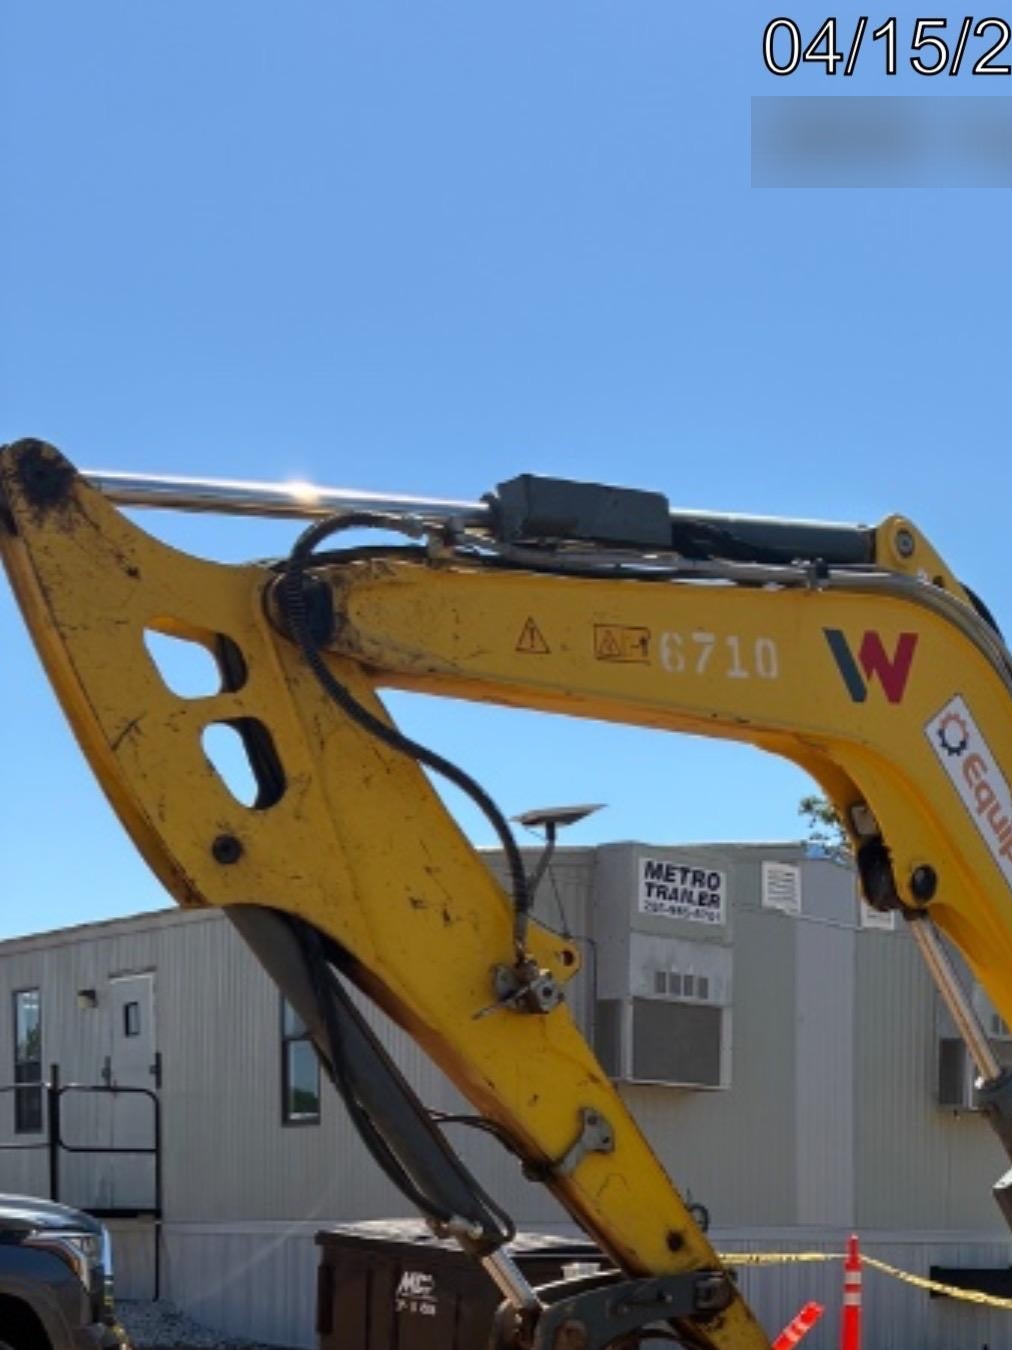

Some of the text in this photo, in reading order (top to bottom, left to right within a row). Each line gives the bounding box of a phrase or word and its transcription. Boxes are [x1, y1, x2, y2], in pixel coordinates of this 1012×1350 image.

[659, 631, 779, 679] 6710
[644, 861, 721, 891] METRO
[644, 881, 721, 909] TRAILER
